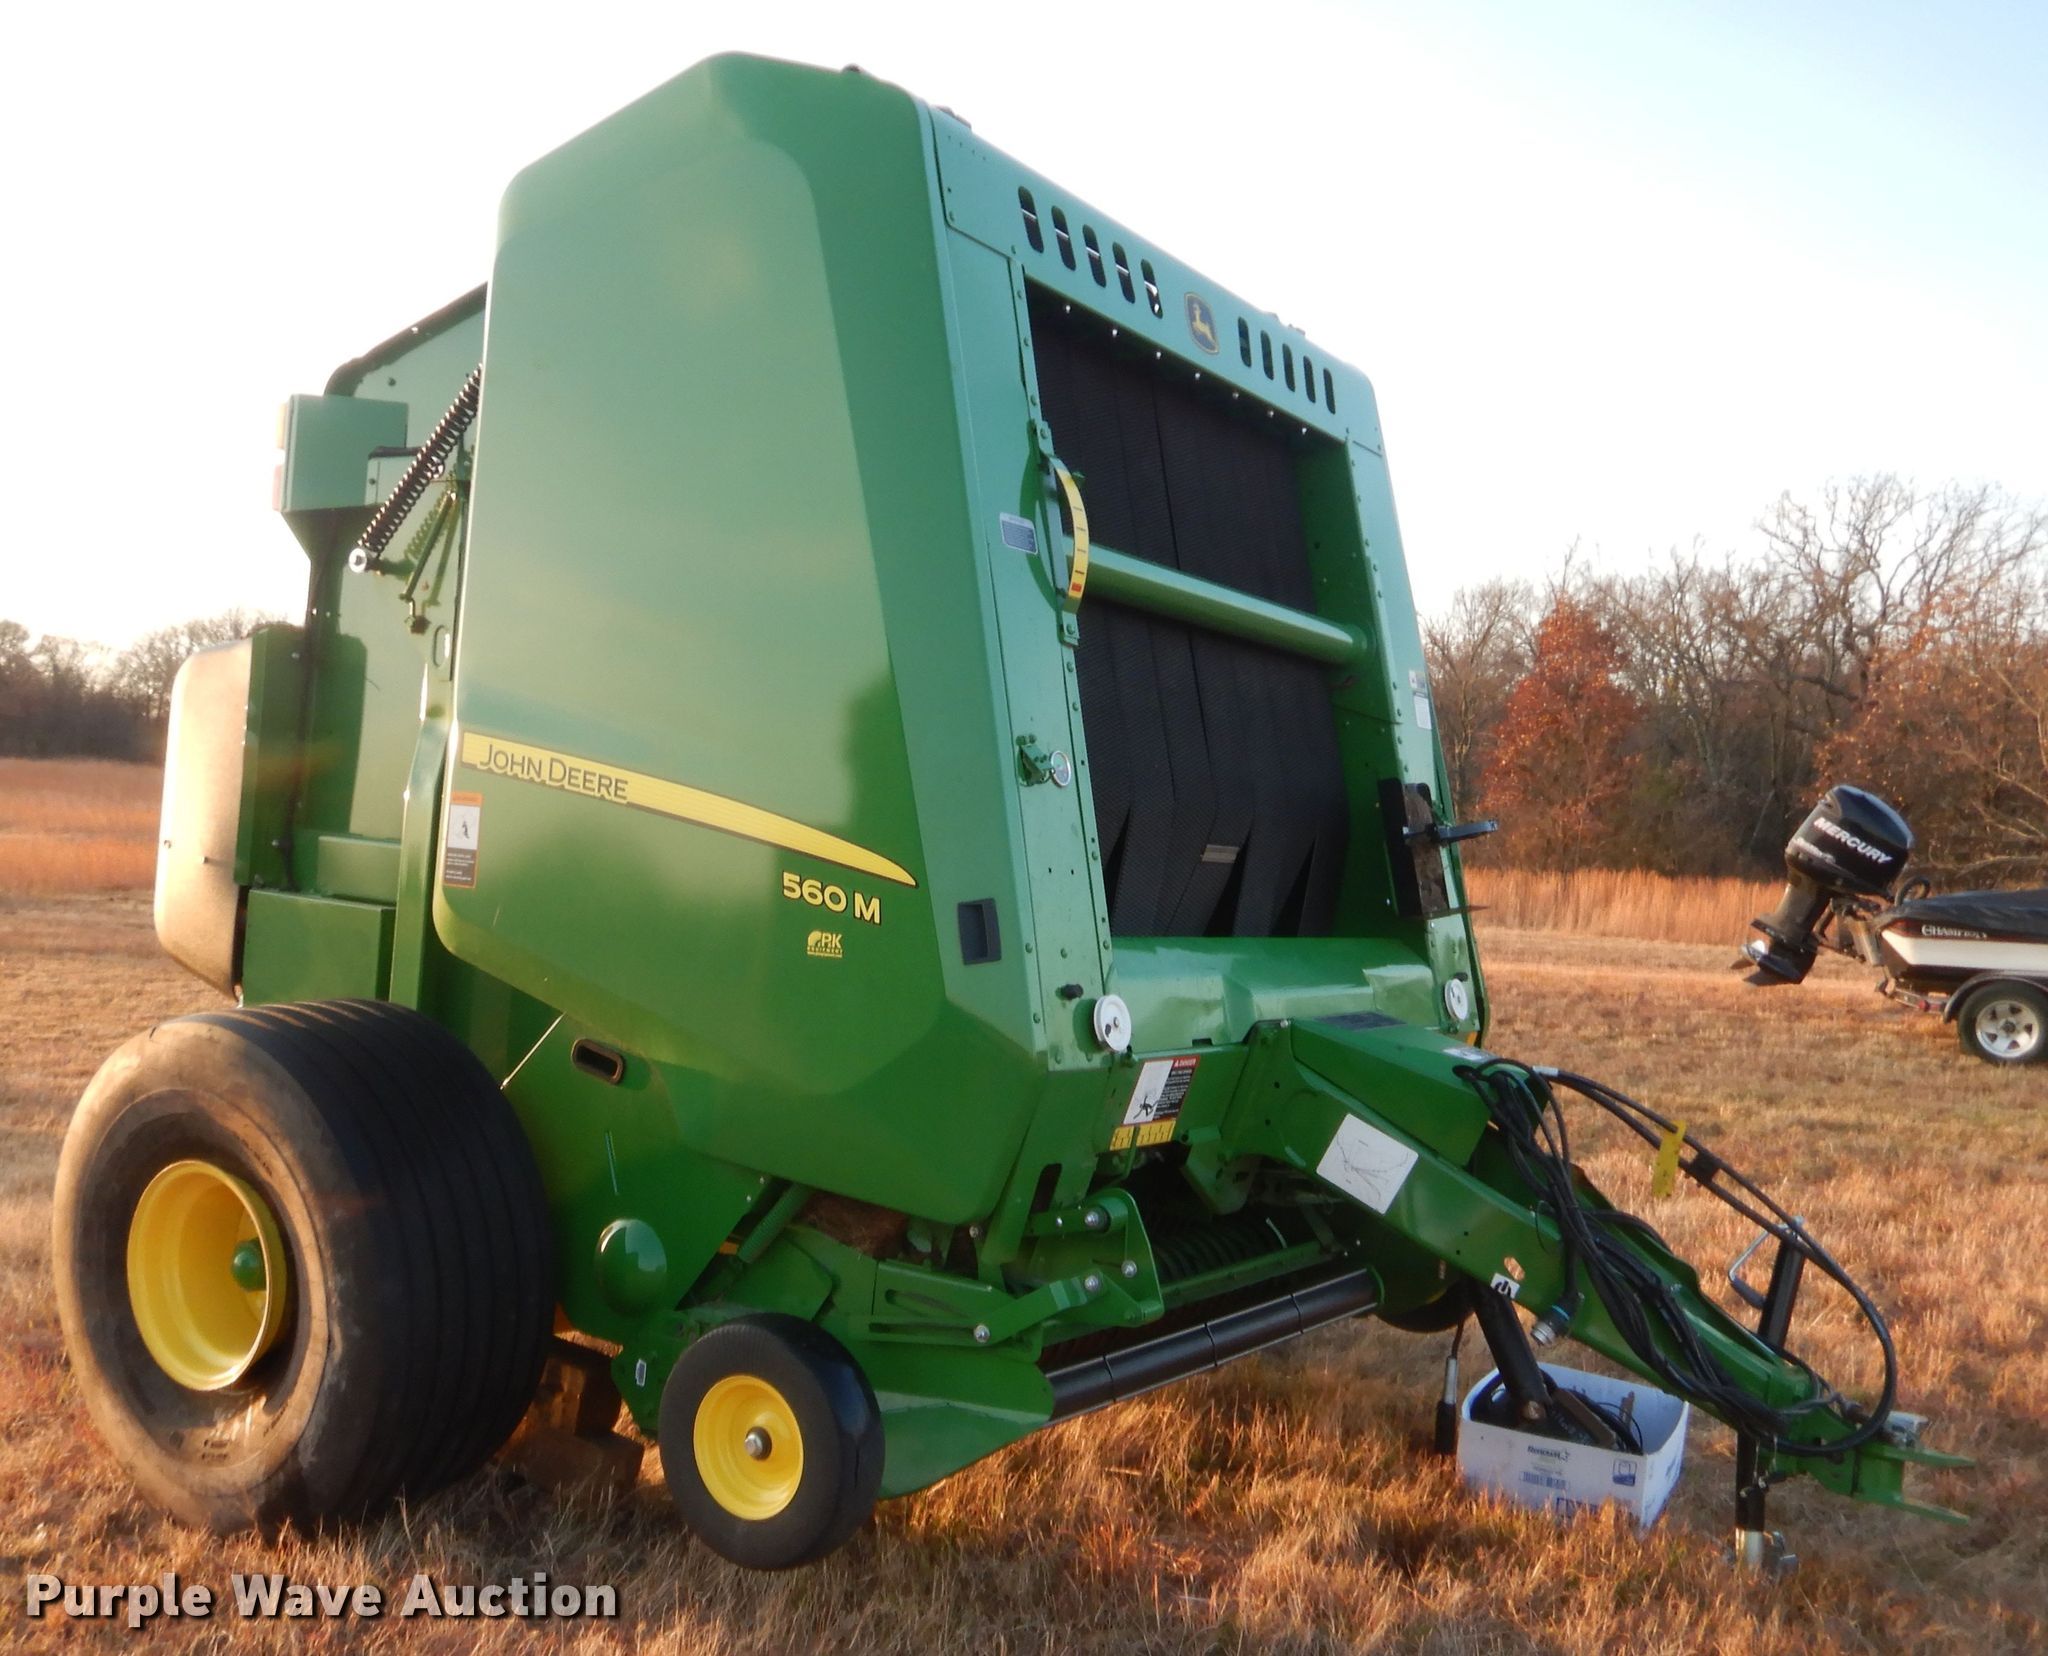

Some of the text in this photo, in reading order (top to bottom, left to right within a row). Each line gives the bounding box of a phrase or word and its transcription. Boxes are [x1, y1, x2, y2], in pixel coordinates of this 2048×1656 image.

[479, 743, 629, 801] JOHN DEERE
[1813, 816, 1893, 864] MERCURY
[783, 871, 881, 925] 560 M
[821, 932, 843, 949] PK
